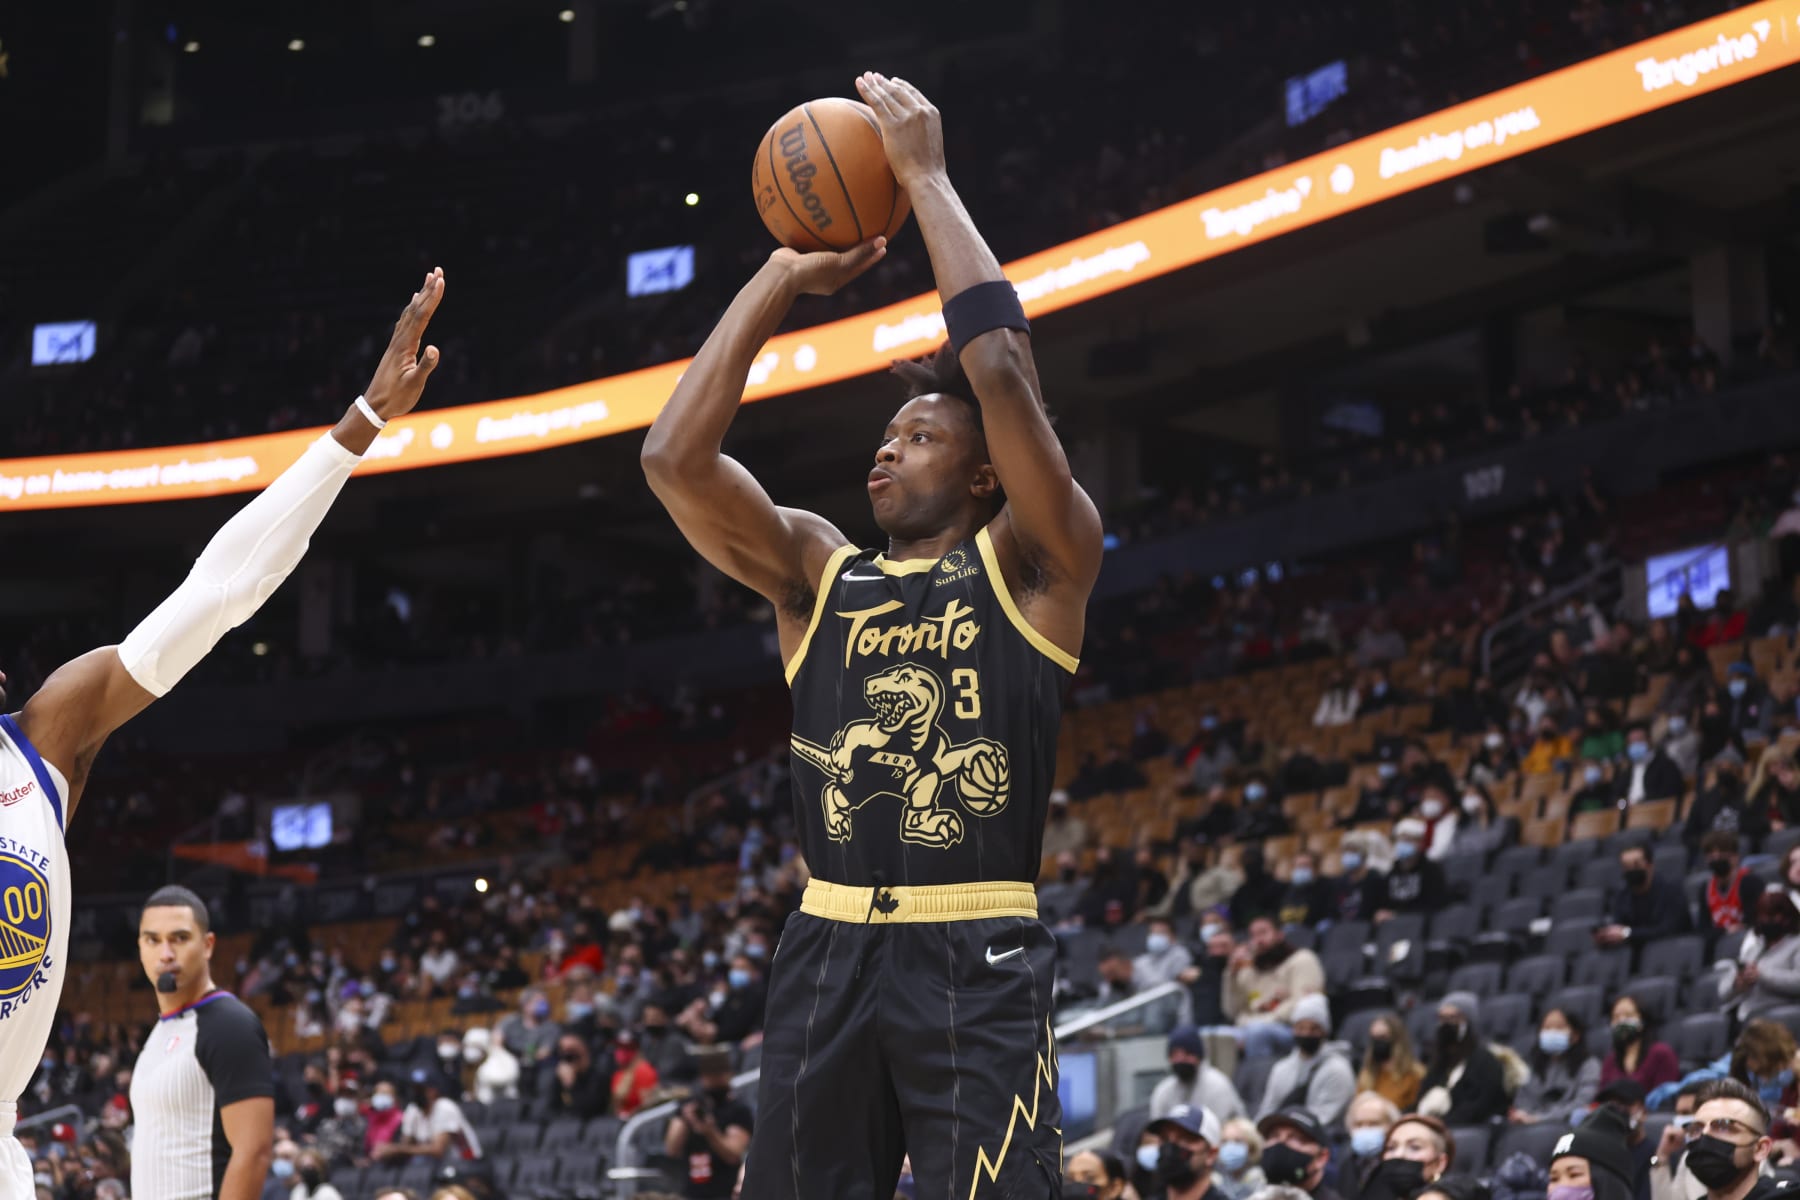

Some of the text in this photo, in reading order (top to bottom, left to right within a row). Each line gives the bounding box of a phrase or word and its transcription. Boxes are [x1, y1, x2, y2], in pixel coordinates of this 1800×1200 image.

[1635, 32, 1759, 92] Tangerine
[1464, 120, 1494, 149] on
[779, 122, 833, 231] Wilson
[25, 474, 51, 495] on
[935, 564, 979, 588] Sun Life
[834, 599, 981, 670] Toronto
[951, 668, 981, 720] 3
[880, 753, 912, 767] NOR
[0, 836, 50, 872] STATE
[4, 881, 43, 924] 00
